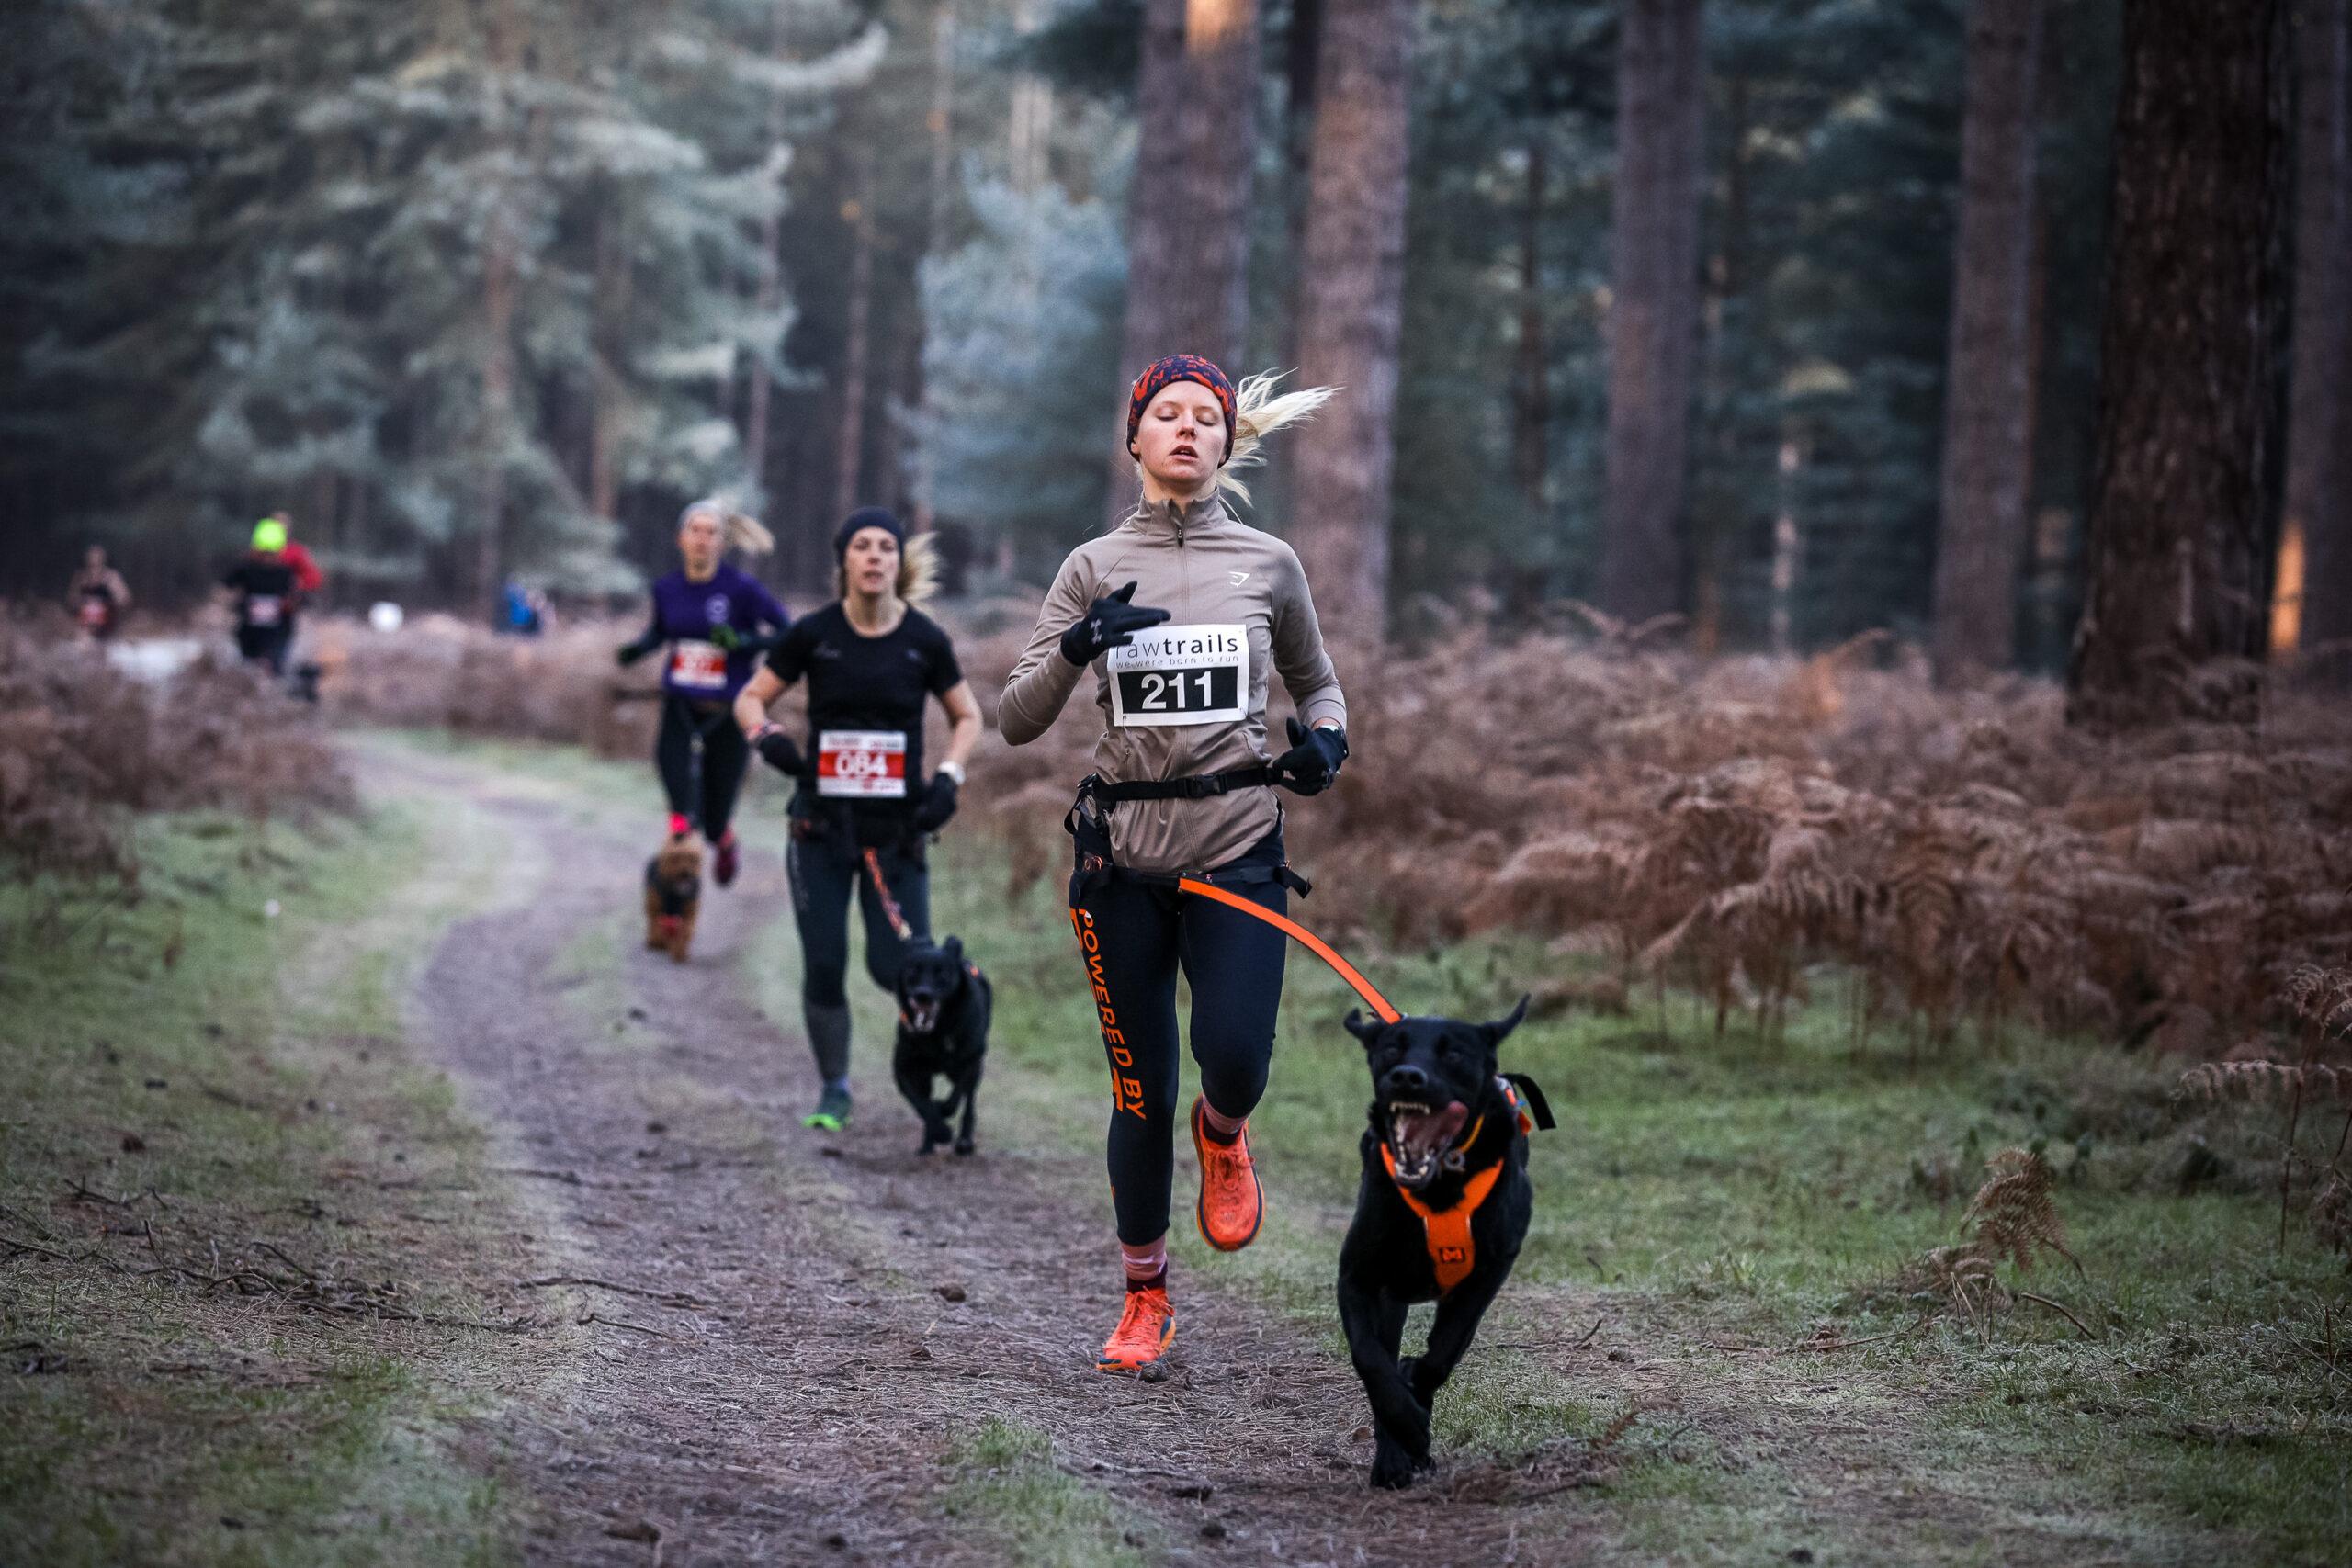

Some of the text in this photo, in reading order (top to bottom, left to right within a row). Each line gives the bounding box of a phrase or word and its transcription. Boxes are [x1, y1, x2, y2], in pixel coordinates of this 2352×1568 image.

[1170, 657, 1196, 665] born
[1219, 655, 1238, 663] run
[1141, 671, 1212, 710] 211
[835, 750, 888, 780] 084
[1079, 908, 1133, 1067] POWERED
[1123, 1077, 1147, 1120] BY
